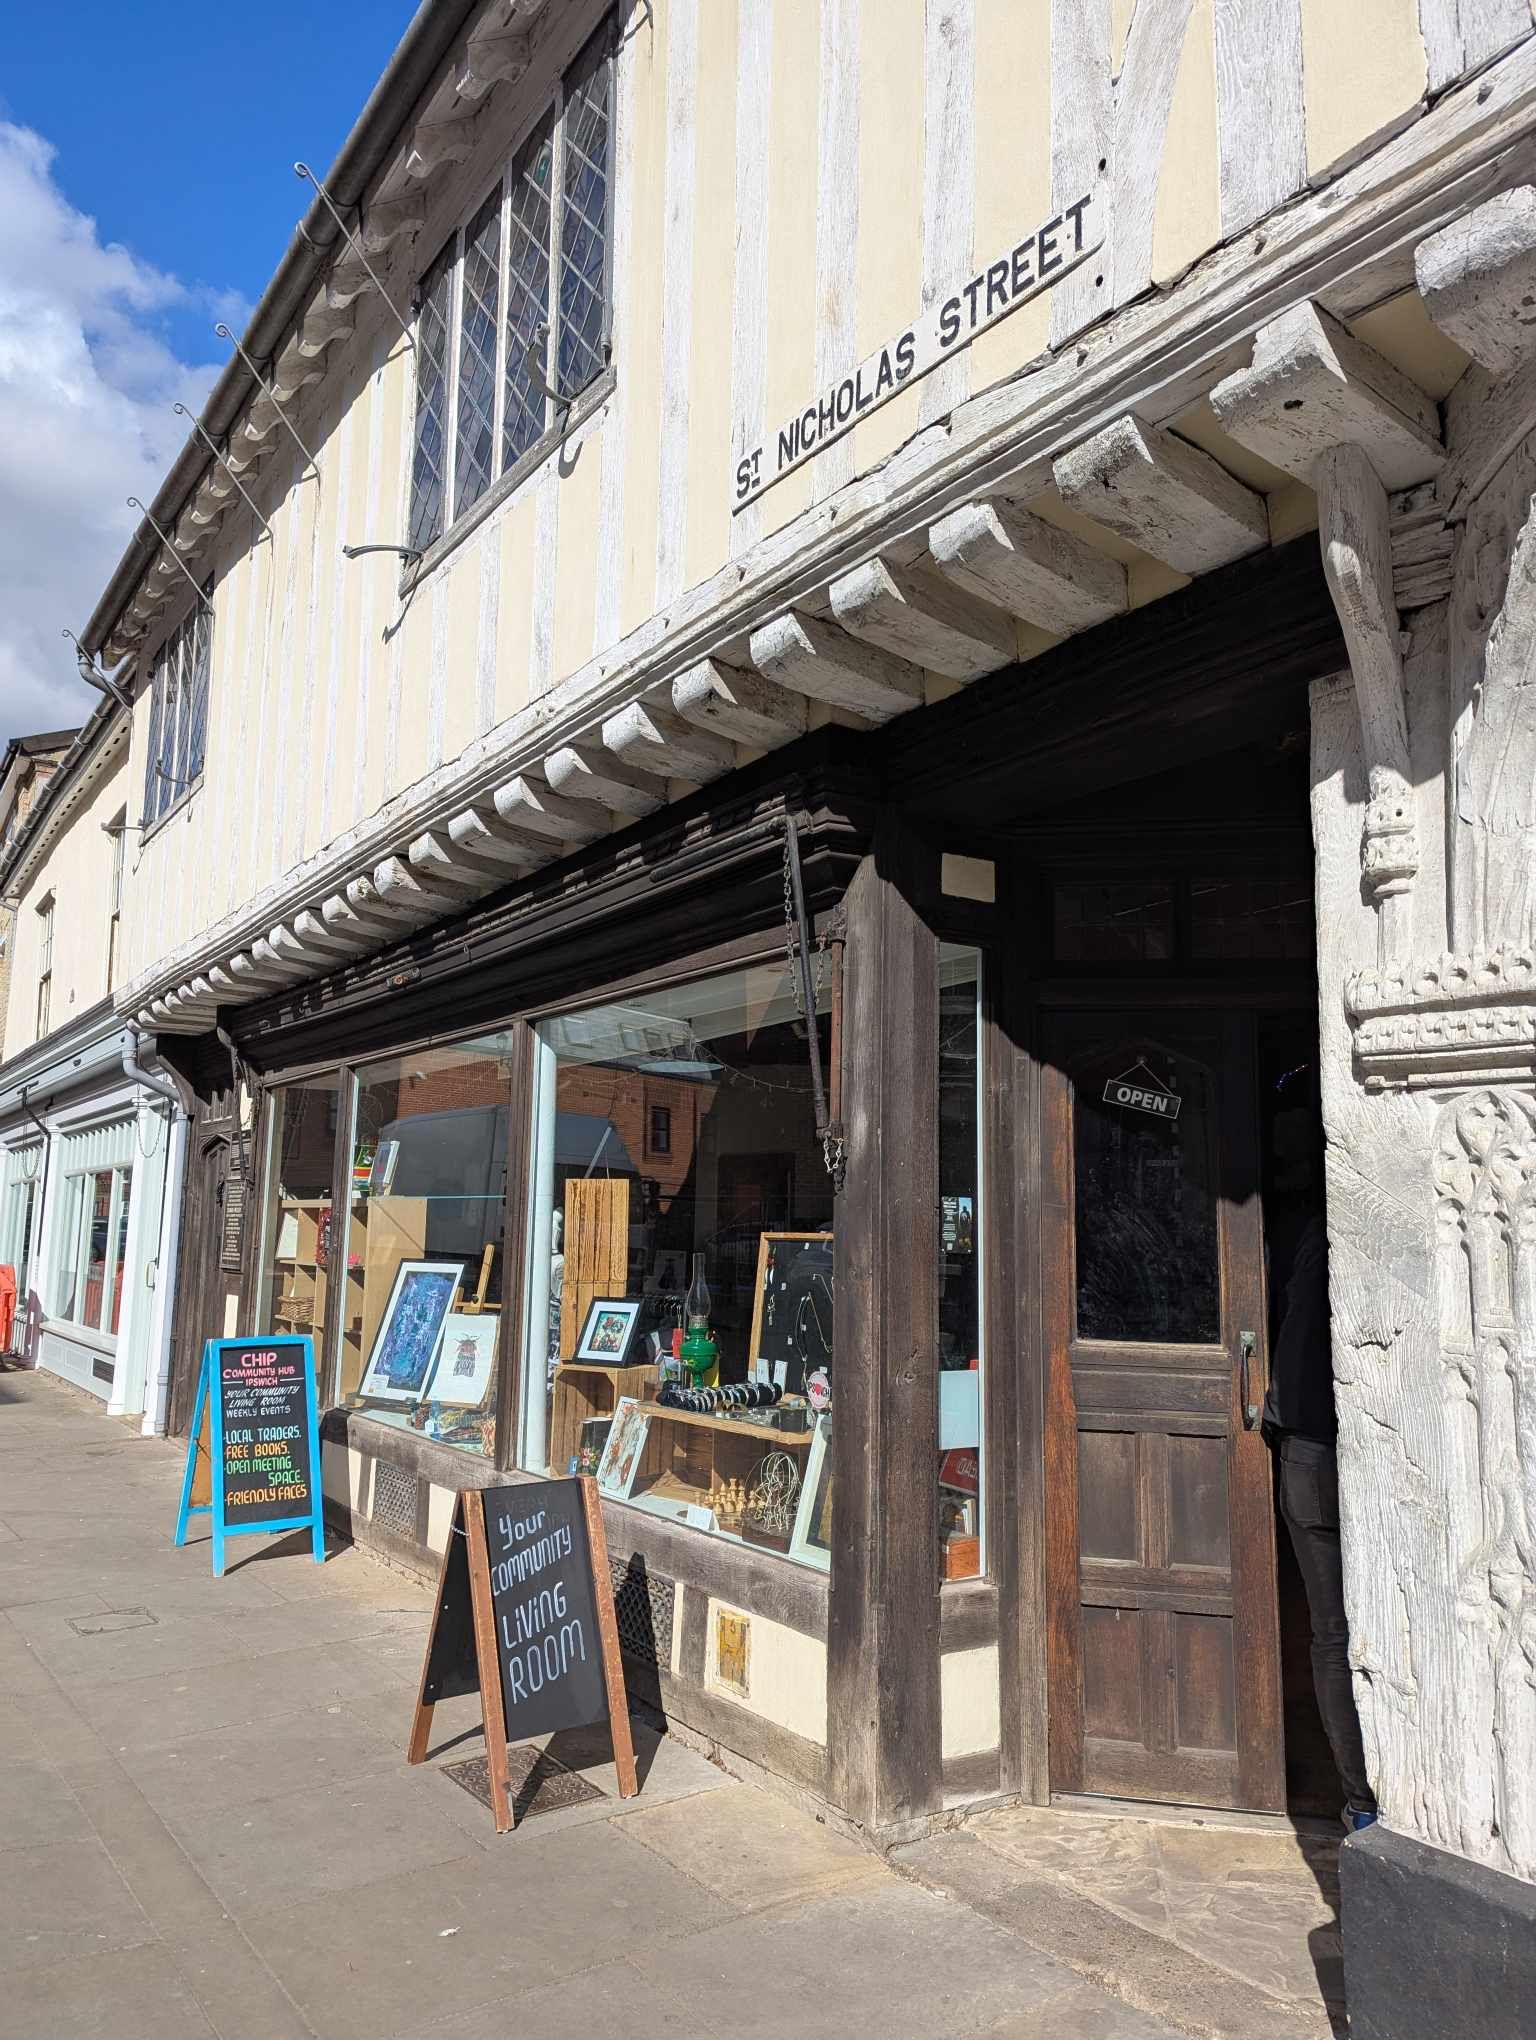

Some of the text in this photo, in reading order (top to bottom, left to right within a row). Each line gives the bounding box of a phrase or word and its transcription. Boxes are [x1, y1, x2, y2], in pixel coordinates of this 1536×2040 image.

[777, 331, 915, 470] NICHOLAS
[939, 194, 1091, 347] STREET
[1117, 1087, 1168, 1112] OPEN
[241, 1352, 277, 1367] CHIP
[222, 1365, 295, 1379] COMMUNITY HUB
[245, 1376, 278, 1387] IPSWICH
[224, 1385, 300, 1399] YOUR COMMUNITY
[228, 1396, 286, 1408] LIVING ROOM
[226, 1404, 291, 1418] WEEKLY EVENTS
[252, 1456, 292, 1473] MEETING
[278, 1484, 307, 1501] FACES
[491, 1524, 572, 1597] COMMUNITY
[509, 1619, 586, 1704] ROOM
